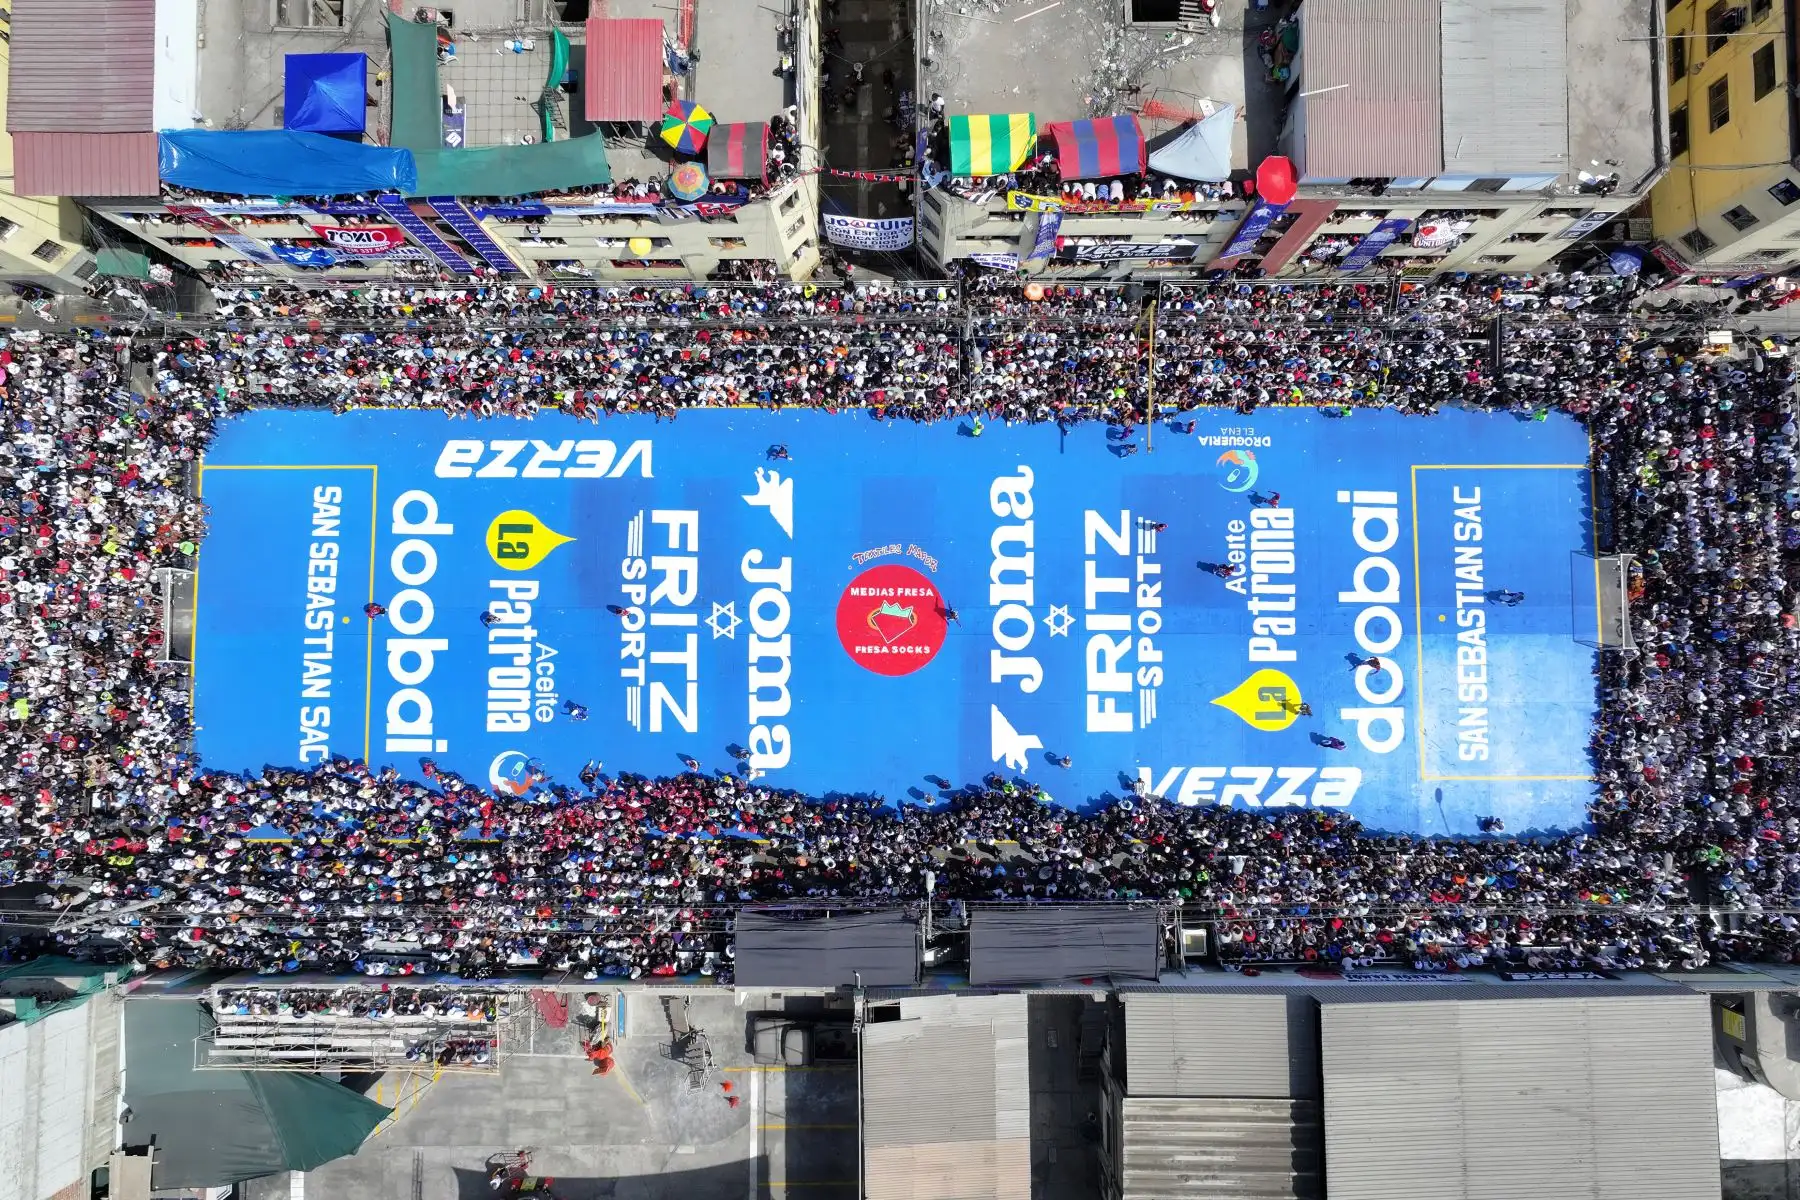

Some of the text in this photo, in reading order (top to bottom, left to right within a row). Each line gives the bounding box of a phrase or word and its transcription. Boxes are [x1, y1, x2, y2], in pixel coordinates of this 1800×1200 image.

[327, 230, 388, 243] TOKIO
[826, 218, 912, 230] JOAQUIN
[827, 225, 850, 235] CON
[831, 231, 899, 241] DEDICACION
[1198, 436, 1271, 447] DROGUERIA
[1220, 427, 1255, 435] ELENA
[850, 587, 934, 597] MEDIAS FRESA
[1225, 519, 1247, 595] Aceite
[299, 486, 342, 762] SAN SEBASTIAN SAC
[386, 490, 454, 753] doobai
[487, 524, 539, 732] La Patrona
[621, 557, 647, 686] SPORT
[650, 509, 699, 733] FRITZ
[855, 645, 930, 654] FRESA SOCKS
[1084, 509, 1134, 733] FRITZ
[1136, 555, 1164, 687] SPORT
[1248, 506, 1297, 721] La Patrona
[1337, 490, 1405, 754] doobai
[1453, 486, 1490, 762] SAN SEBASTIAN SAC
[535, 642, 559, 723] Aceite
